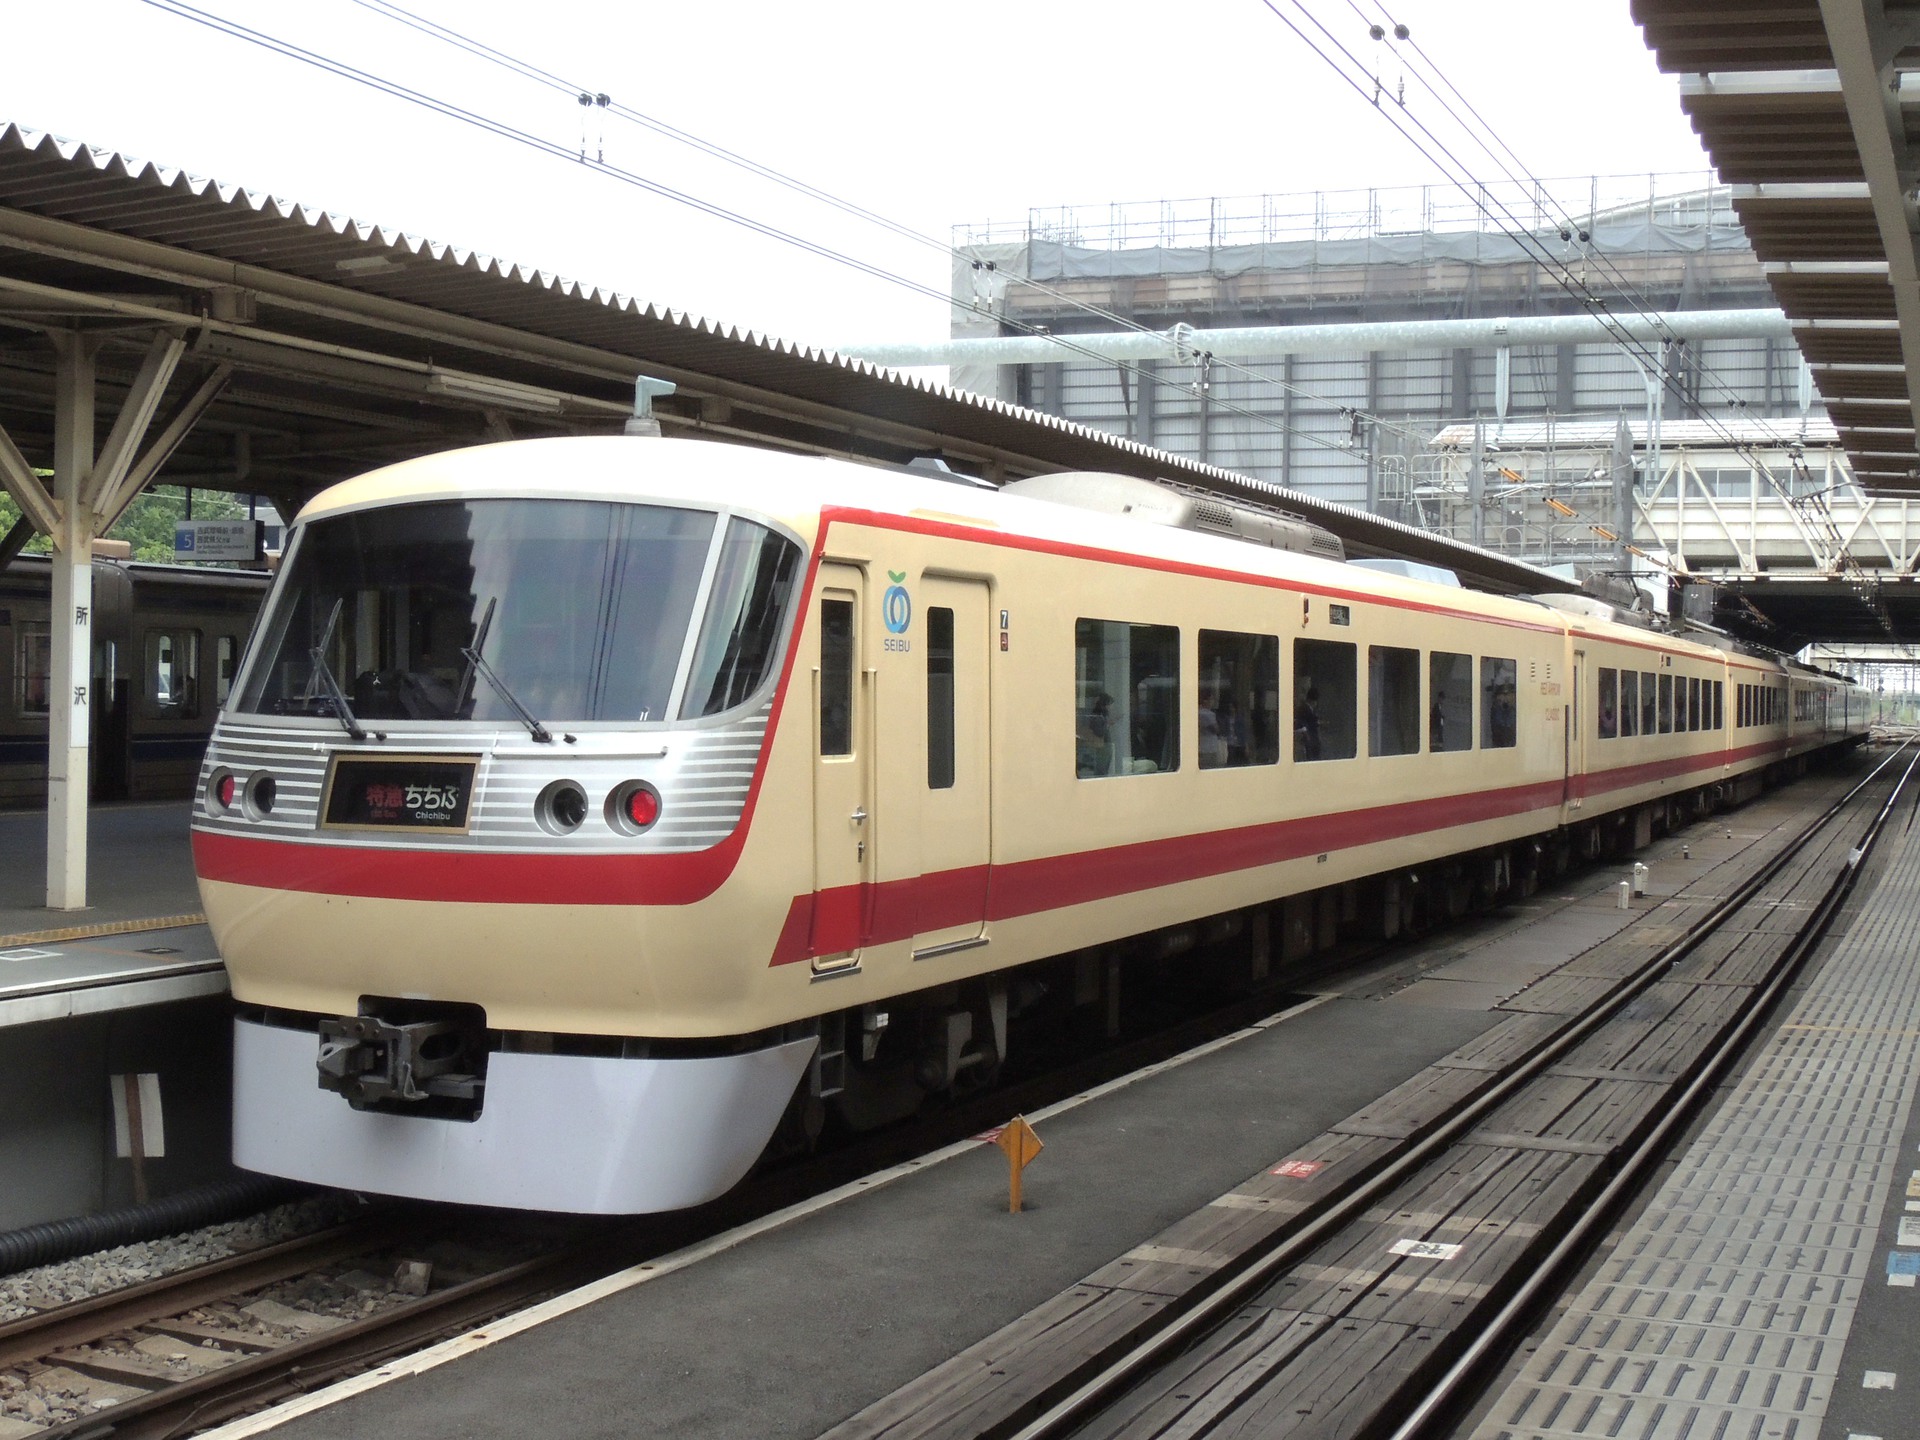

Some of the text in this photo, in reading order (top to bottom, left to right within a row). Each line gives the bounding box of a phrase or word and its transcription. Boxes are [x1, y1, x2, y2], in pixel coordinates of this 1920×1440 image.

[184, 534, 192, 548] 5
[1001, 611, 1007, 628] 7
[884, 638, 910, 652] SEIBU
[74, 606, 88, 705] 所沢
[405, 784, 459, 809] ちちぶ
[415, 811, 451, 820] Chichibu
[1635, 868, 1642, 876] 9
